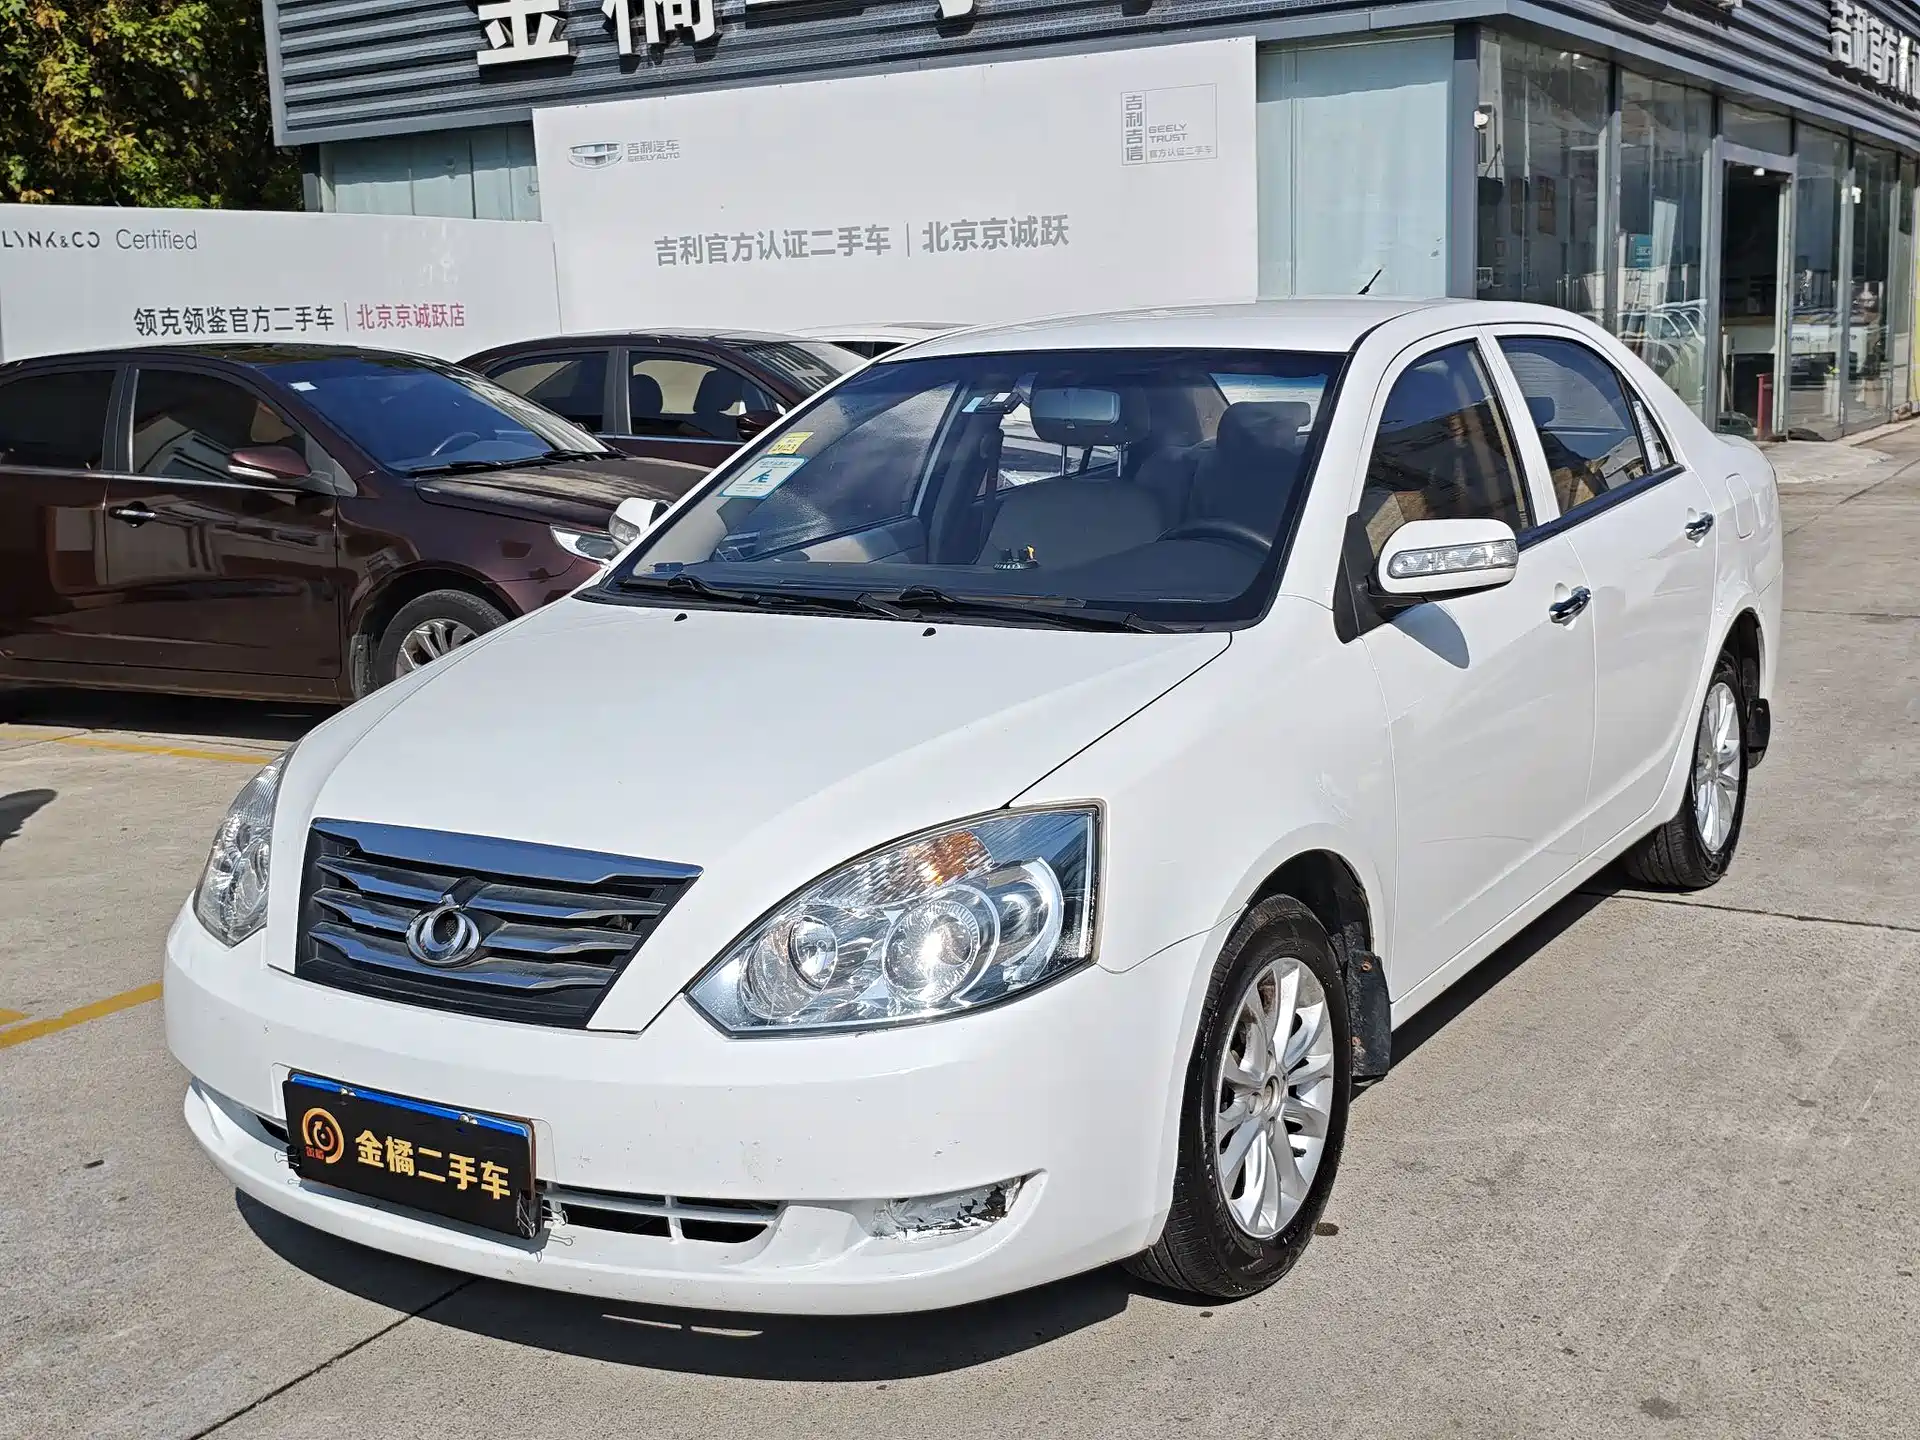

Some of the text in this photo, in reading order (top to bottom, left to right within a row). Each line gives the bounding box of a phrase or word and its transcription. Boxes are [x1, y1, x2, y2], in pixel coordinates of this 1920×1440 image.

[1148, 122, 1188, 134] GEELY
[1148, 132, 1188, 144] TRUST
[115, 228, 198, 250] Certified
[655, 214, 1070, 266] 吉利官方认证二手车 北京京诚跃
[134, 303, 465, 337] 领克领鉴官方二手车 北京京诚跃店
[355, 1129, 511, 1200] 金橘二手车
